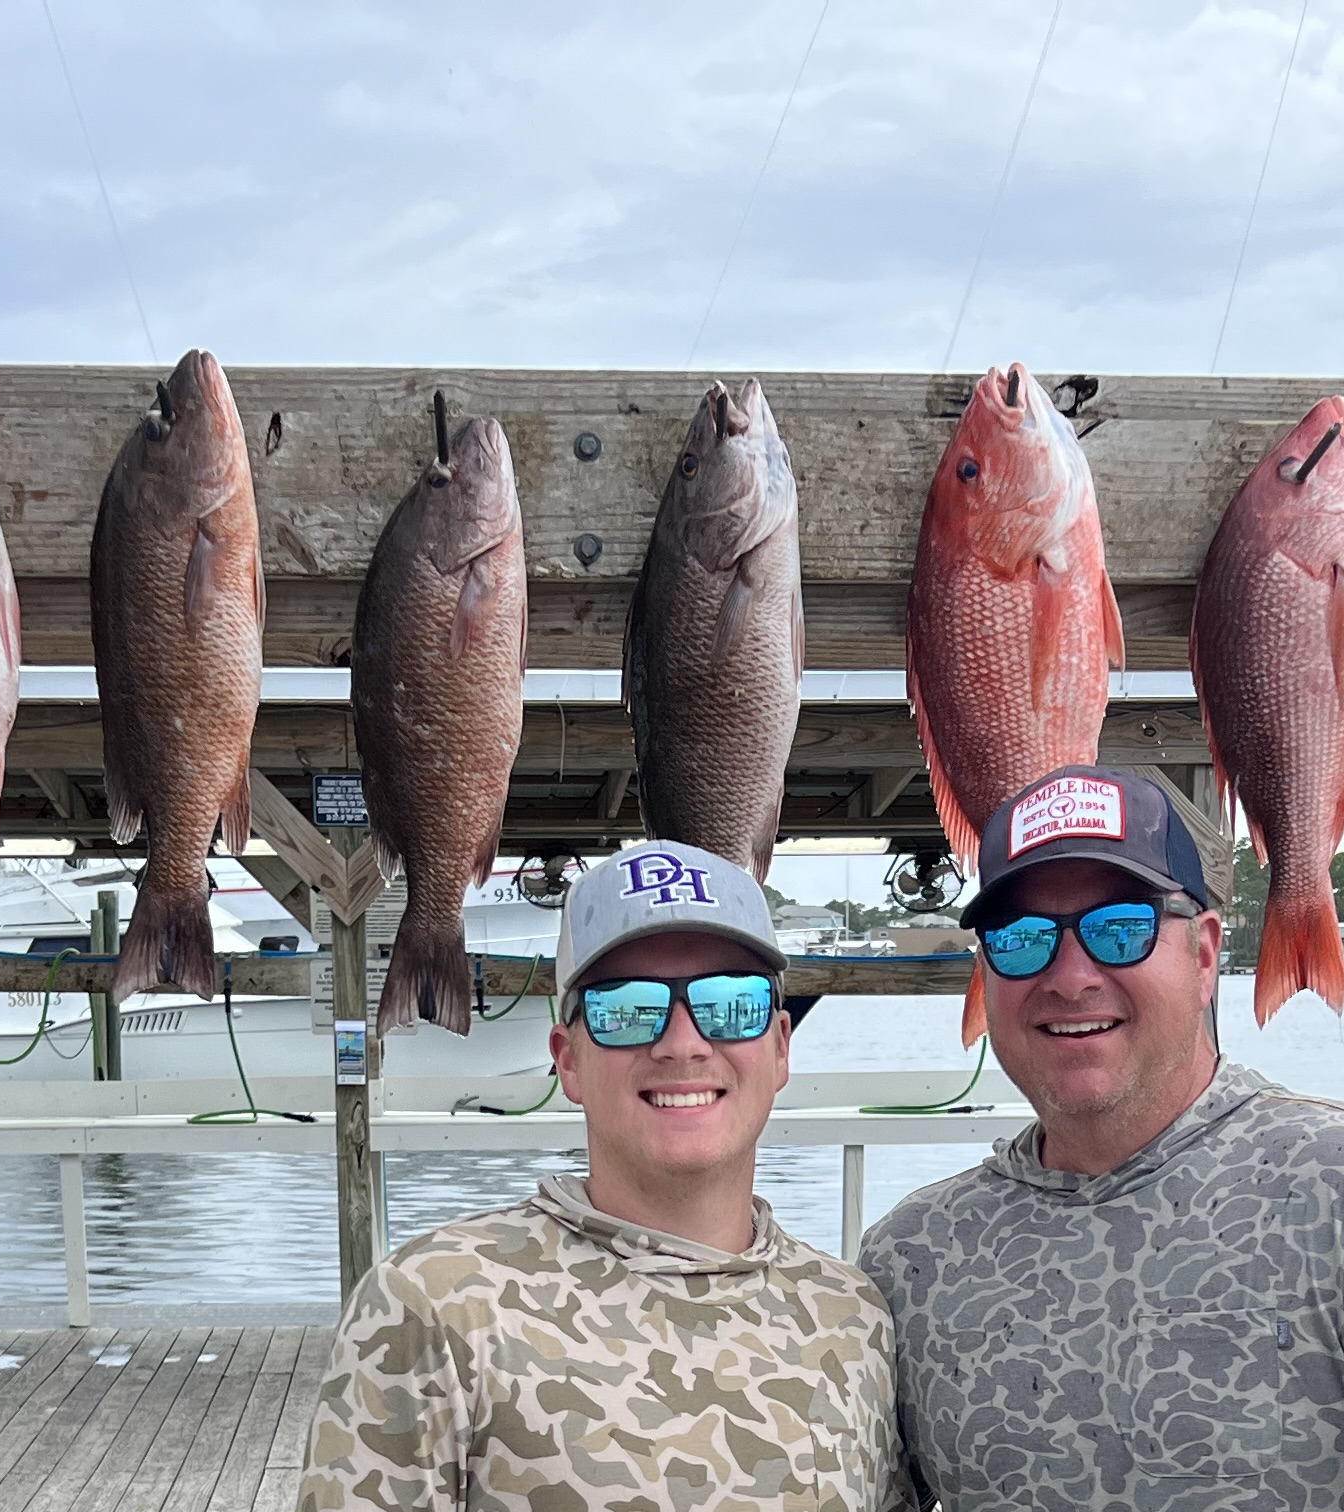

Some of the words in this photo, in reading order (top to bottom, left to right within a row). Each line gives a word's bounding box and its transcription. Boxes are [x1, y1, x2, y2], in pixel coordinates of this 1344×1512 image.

[1017, 780, 1078, 814] TEMPLE
[1081, 781, 1114, 798] INC.
[1023, 808, 1046, 826] EST.
[1079, 801, 1107, 811] 1954
[1021, 820, 1062, 844] DECATUR,
[1063, 817, 1107, 830] ALABAMA
[618, 851, 717, 906] DH
